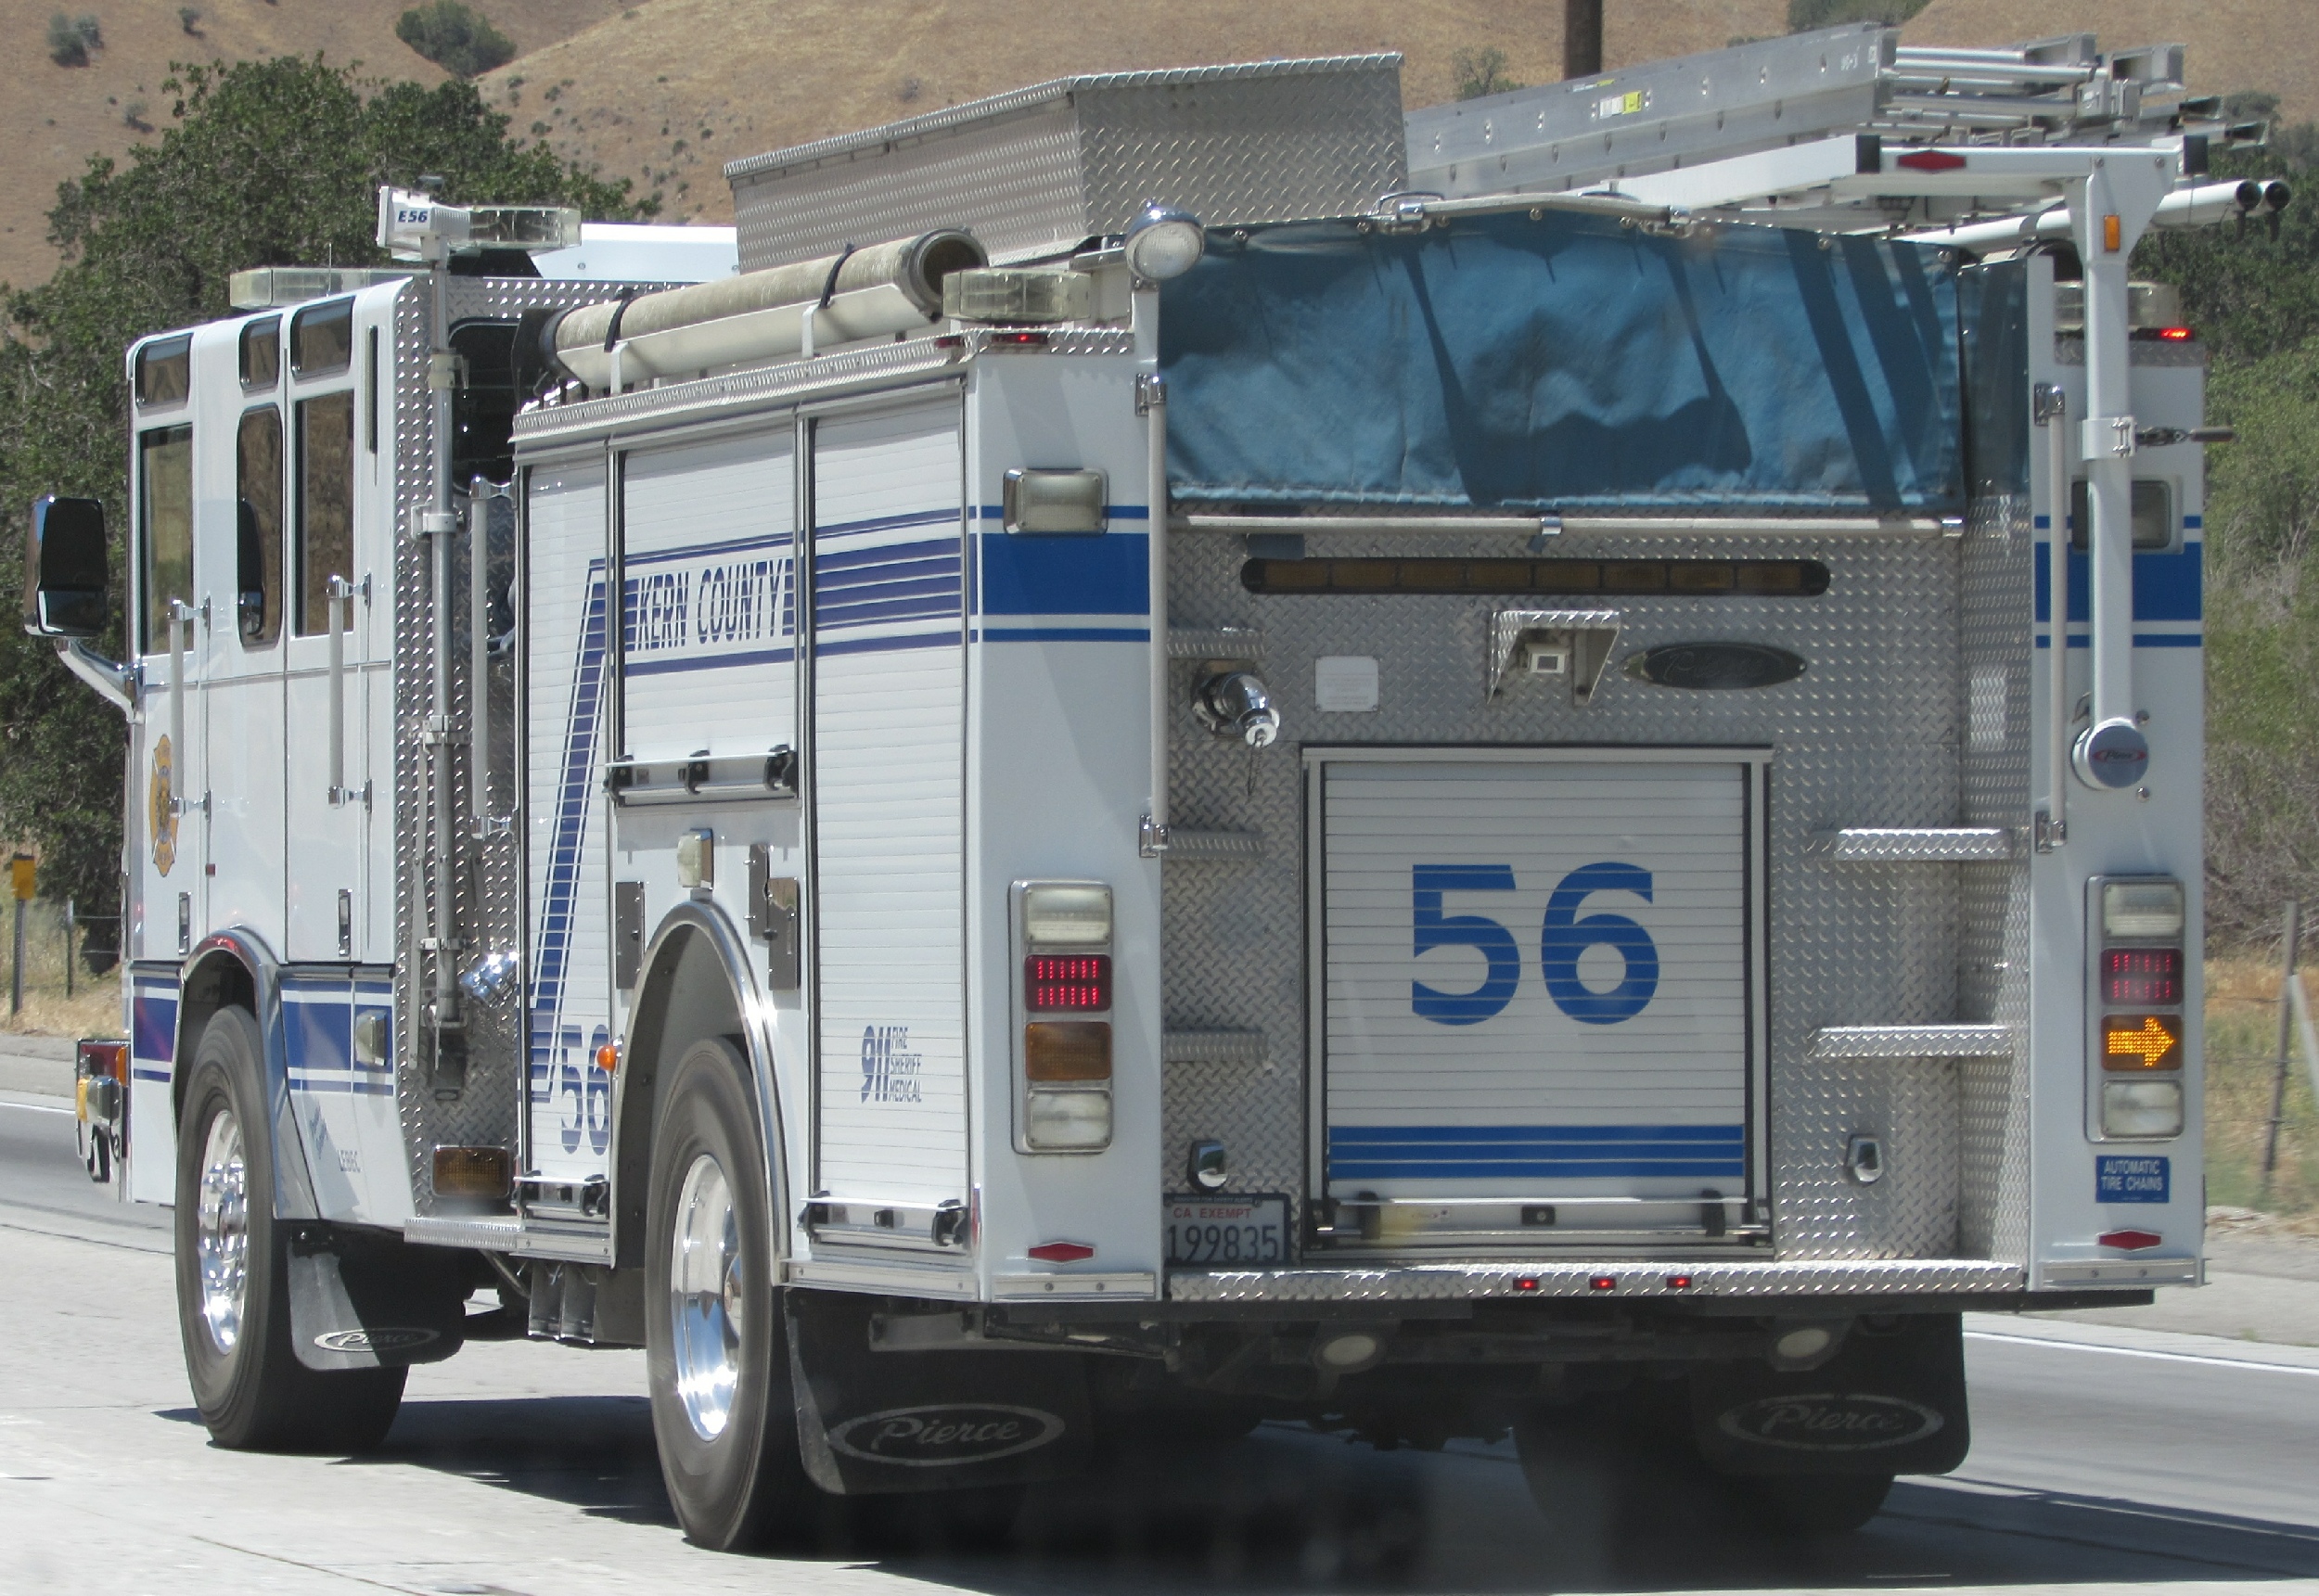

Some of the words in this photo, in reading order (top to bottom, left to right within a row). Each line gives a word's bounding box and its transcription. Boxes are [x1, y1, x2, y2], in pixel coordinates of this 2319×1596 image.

[398, 211, 429, 223] E56
[636, 570, 690, 652] KERN
[697, 558, 785, 645] COUNTY
[1412, 862, 1660, 1026] 56
[890, 1027, 909, 1050] FIRE
[861, 1025, 891, 1104] 911
[890, 1053, 922, 1075] SHERIFF
[561, 1024, 609, 1156] 56
[889, 1079, 922, 1104] MEDICAL
[2103, 1159, 2161, 1175] AUTOMATIC
[2100, 1175, 2123, 1191] TIRE
[2126, 1175, 2163, 1192] CHAINS
[1173, 1207, 1192, 1219] CA
[1199, 1207, 1252, 1219] EXEMPT
[1167, 1223, 1278, 1262] 199835
[870, 1415, 1021, 1451] Pierce
